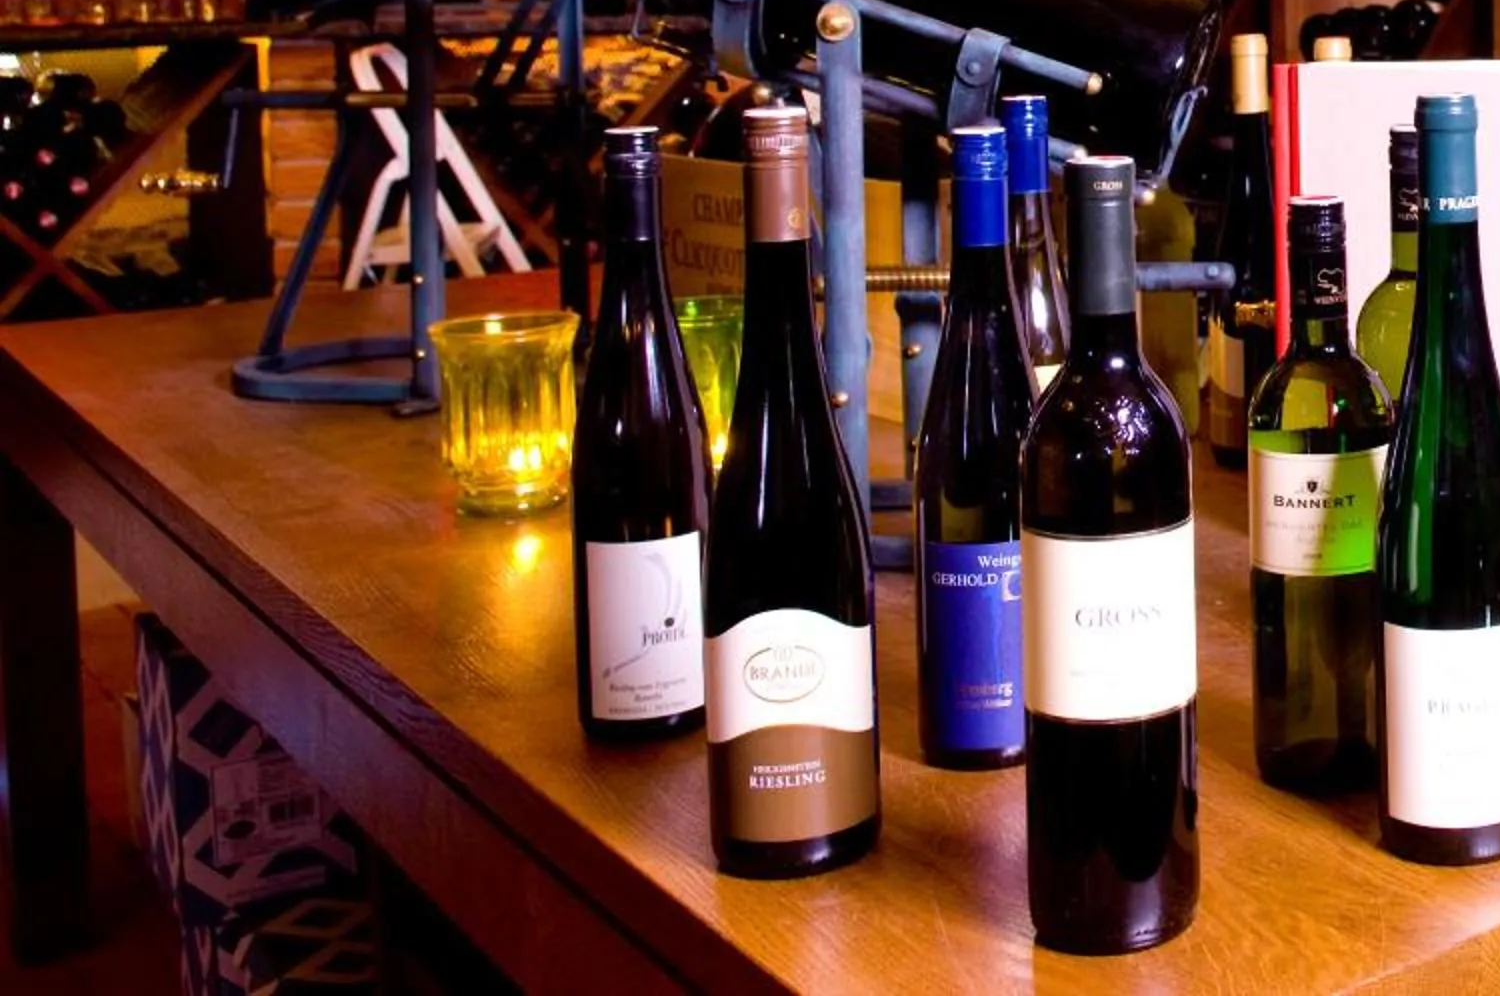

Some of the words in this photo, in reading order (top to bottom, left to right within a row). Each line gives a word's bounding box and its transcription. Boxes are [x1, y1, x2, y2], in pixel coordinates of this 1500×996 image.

[1273, 494, 1356, 510] BANNERT
[931, 571, 999, 588] GERHOLD
[749, 770, 827, 789] RIESLING
